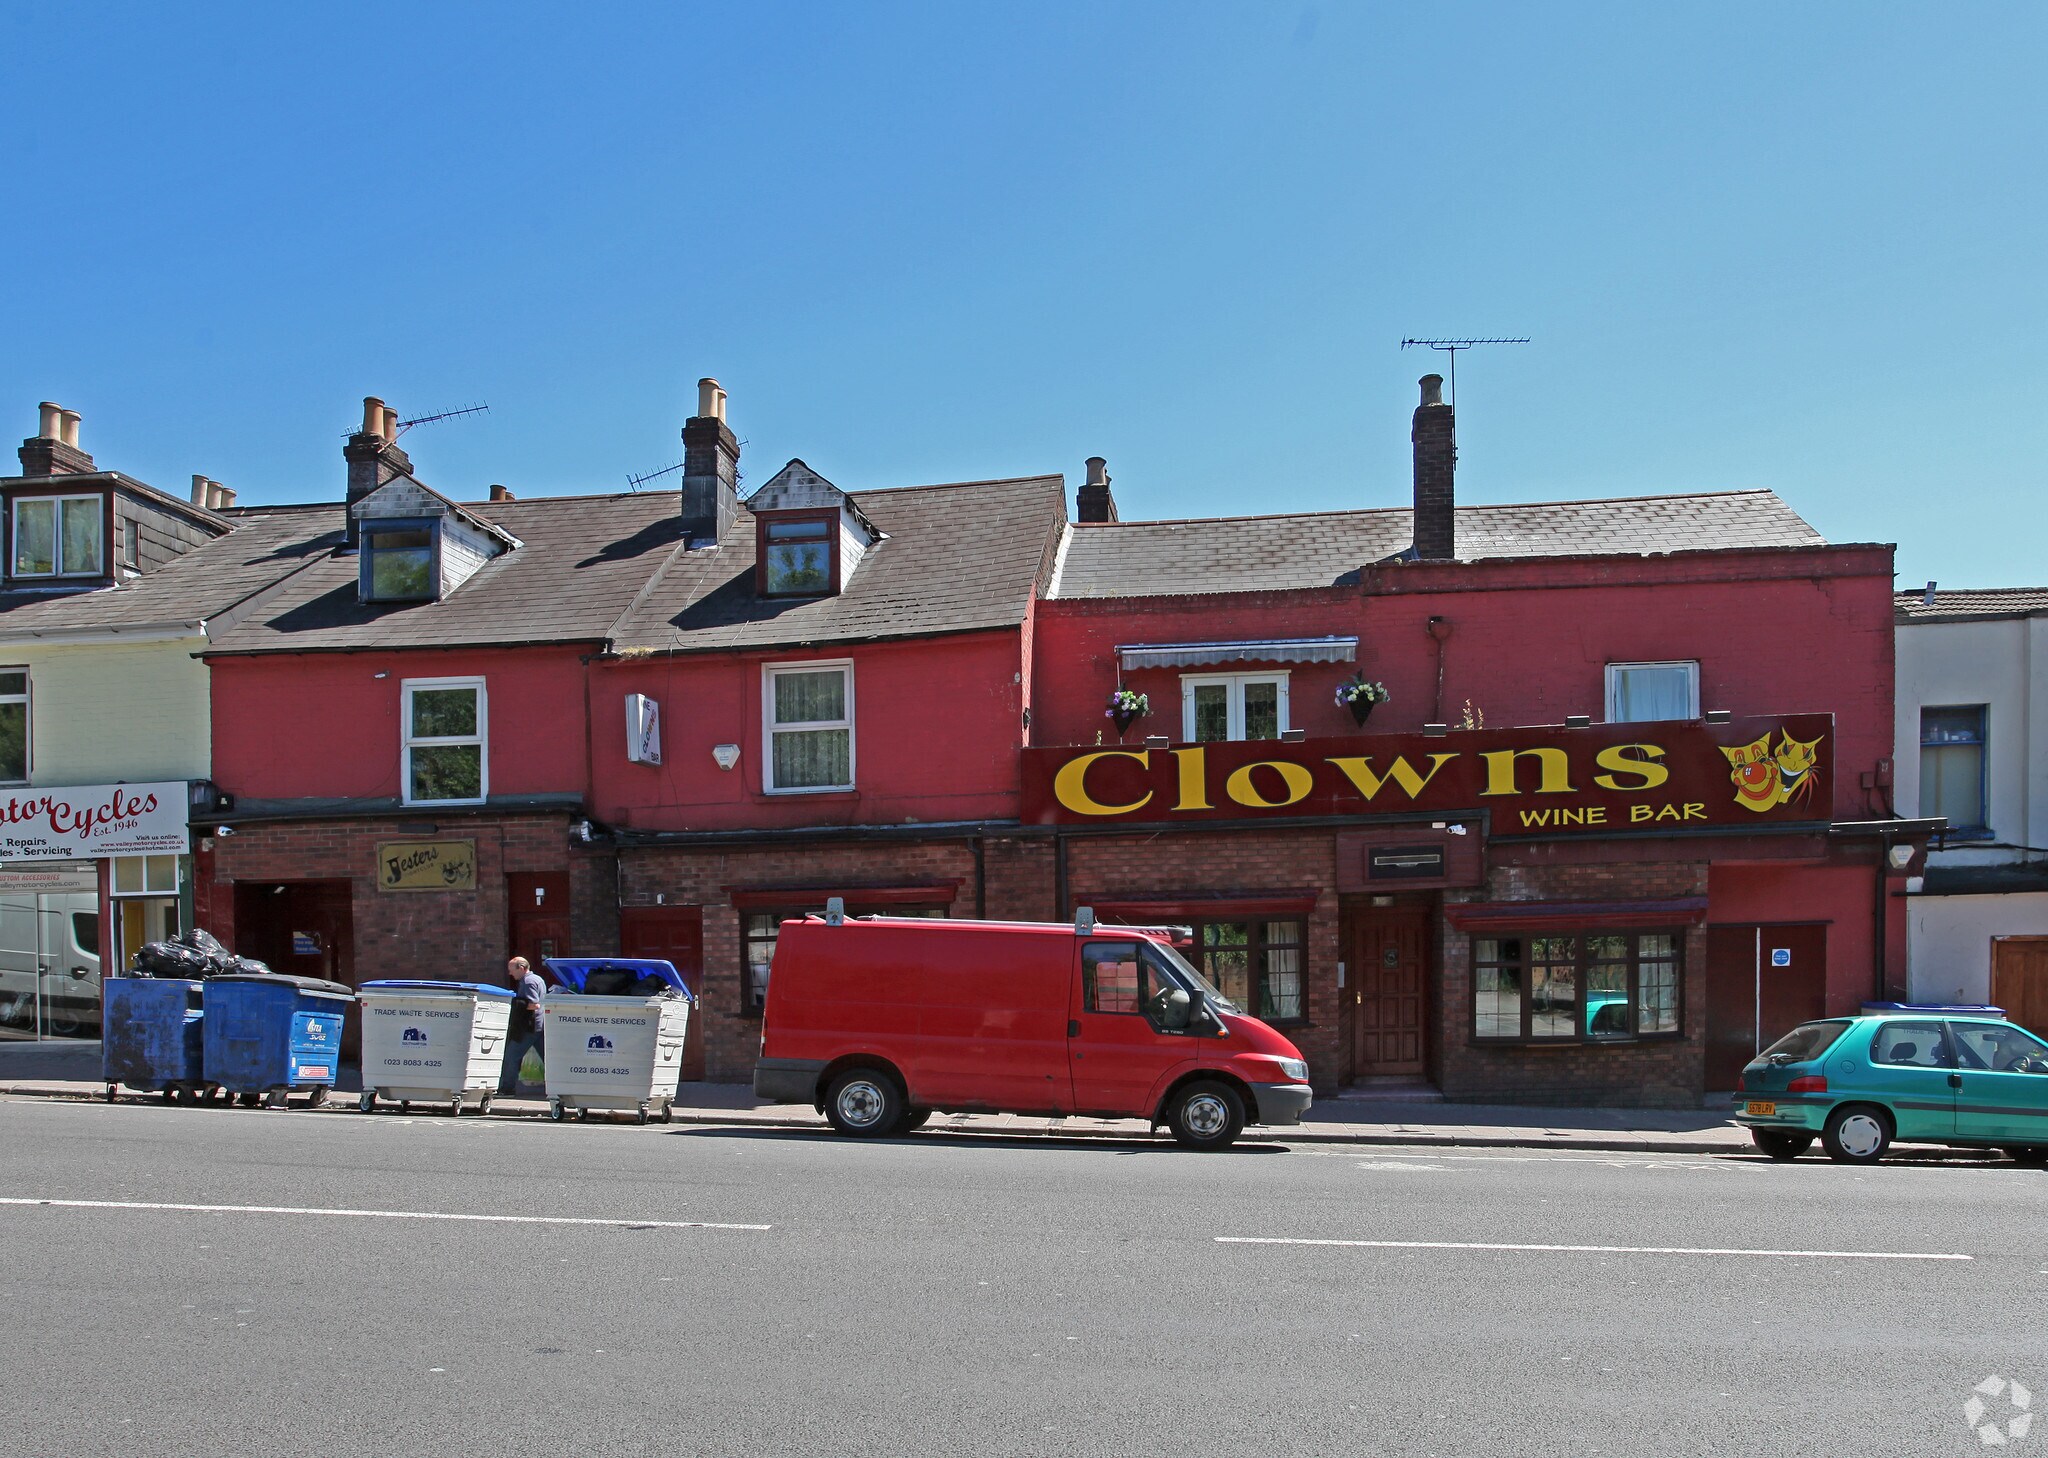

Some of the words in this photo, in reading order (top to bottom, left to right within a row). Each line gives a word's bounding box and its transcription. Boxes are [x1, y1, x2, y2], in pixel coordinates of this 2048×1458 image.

[1054, 743, 1670, 815] Clowns
[50, 788, 158, 839] Cycles
[1519, 807, 1607, 827] WINE
[1630, 803, 1708, 822] BAR
[93, 826, 111, 837] Est.
[113, 818, 138, 833] 1946
[6, 838, 47, 849] Repairs
[23, 846, 72, 857] Servicing
[386, 846, 439, 884] Jesters
[21, 873, 61, 881] ACCESSORIES
[374, 1008, 397, 1016] TRADE
[399, 1009, 422, 1017] WASTE
[425, 1010, 460, 1019] SERVICES
[558, 1015, 582, 1023] TRADE
[584, 1016, 608, 1024] WASTE
[611, 1017, 646, 1026] SERVICES
[403, 1059, 422, 1067] 8083
[425, 1060, 442, 1068] 4325
[589, 1067, 609, 1075] 8083
[611, 1068, 630, 1076] 4325
